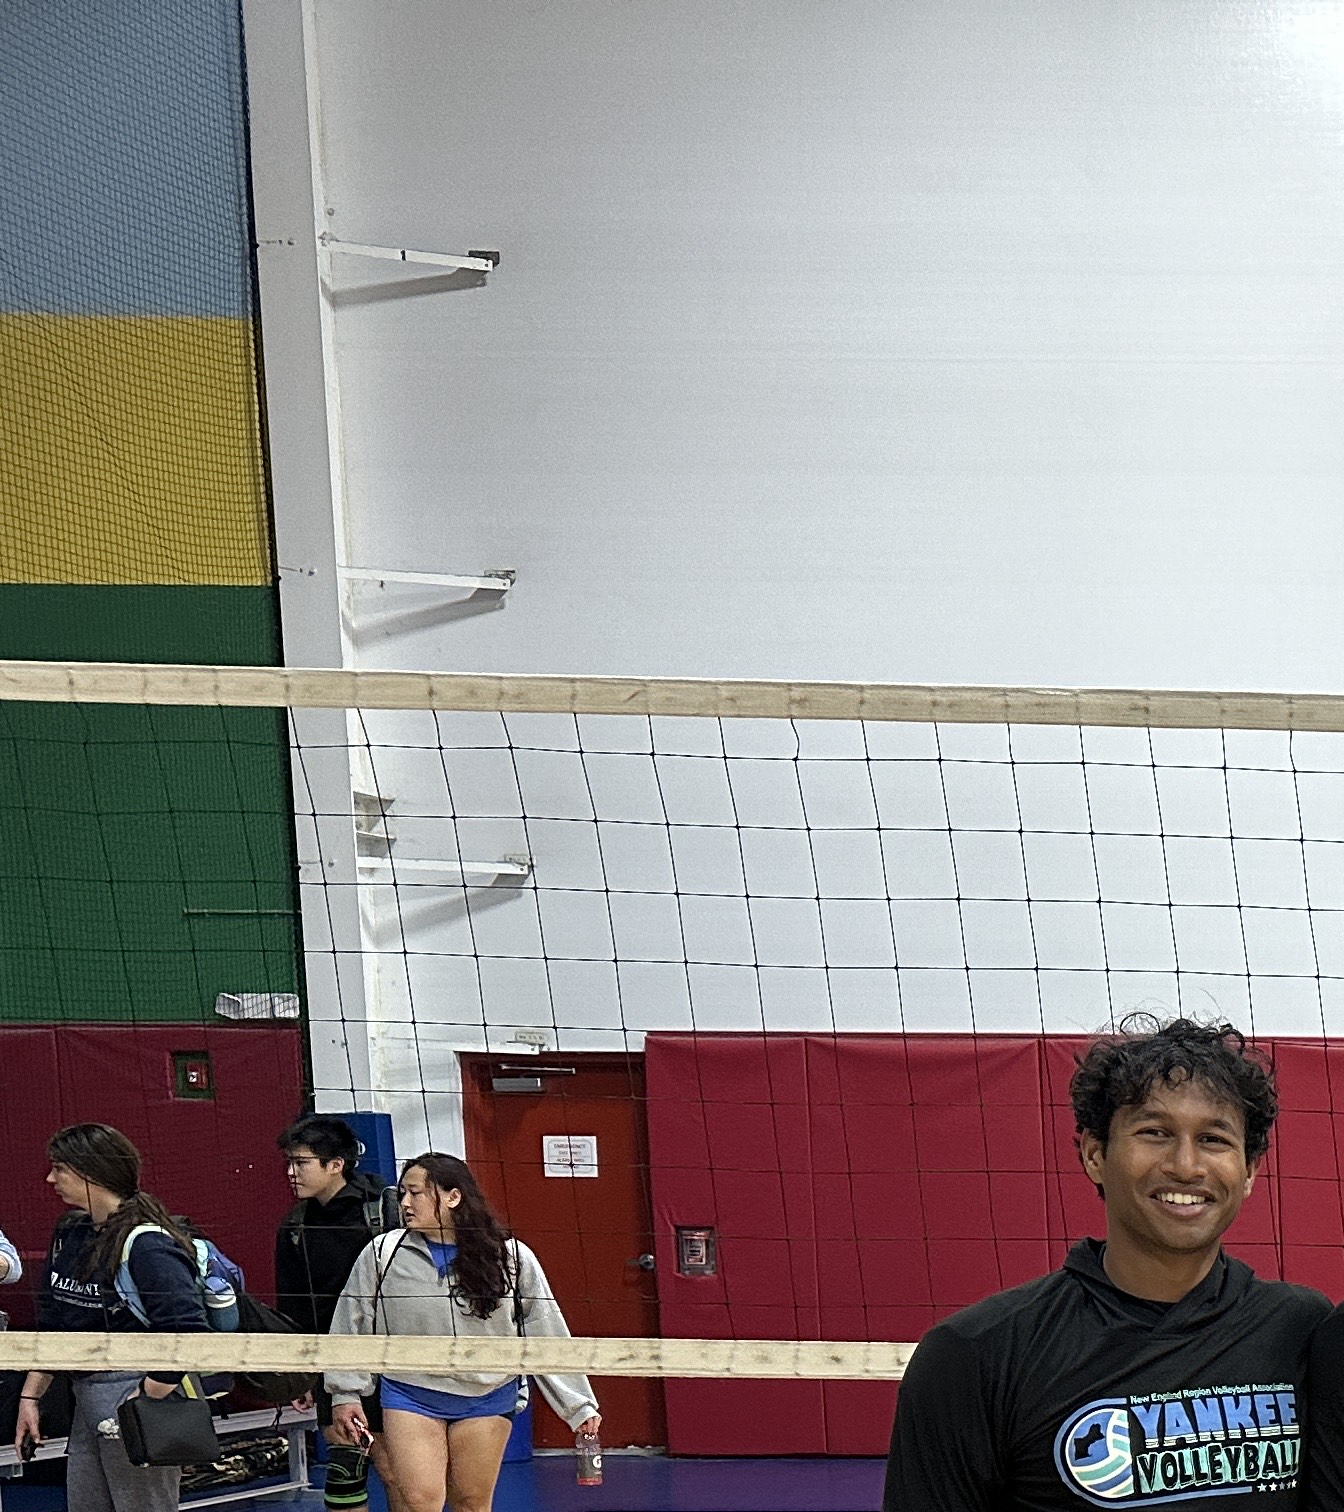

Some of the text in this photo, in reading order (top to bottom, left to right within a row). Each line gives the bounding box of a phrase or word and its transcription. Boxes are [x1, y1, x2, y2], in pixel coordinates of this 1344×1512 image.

[1130, 1395, 1150, 1404] New
[1151, 1390, 1182, 1402] England
[1183, 1386, 1211, 1399] Region
[1212, 1383, 1251, 1395] Volleyball
[1131, 1393, 1299, 1448] YANKEE
[1137, 1438, 1300, 1493] VOLLEYBALL
